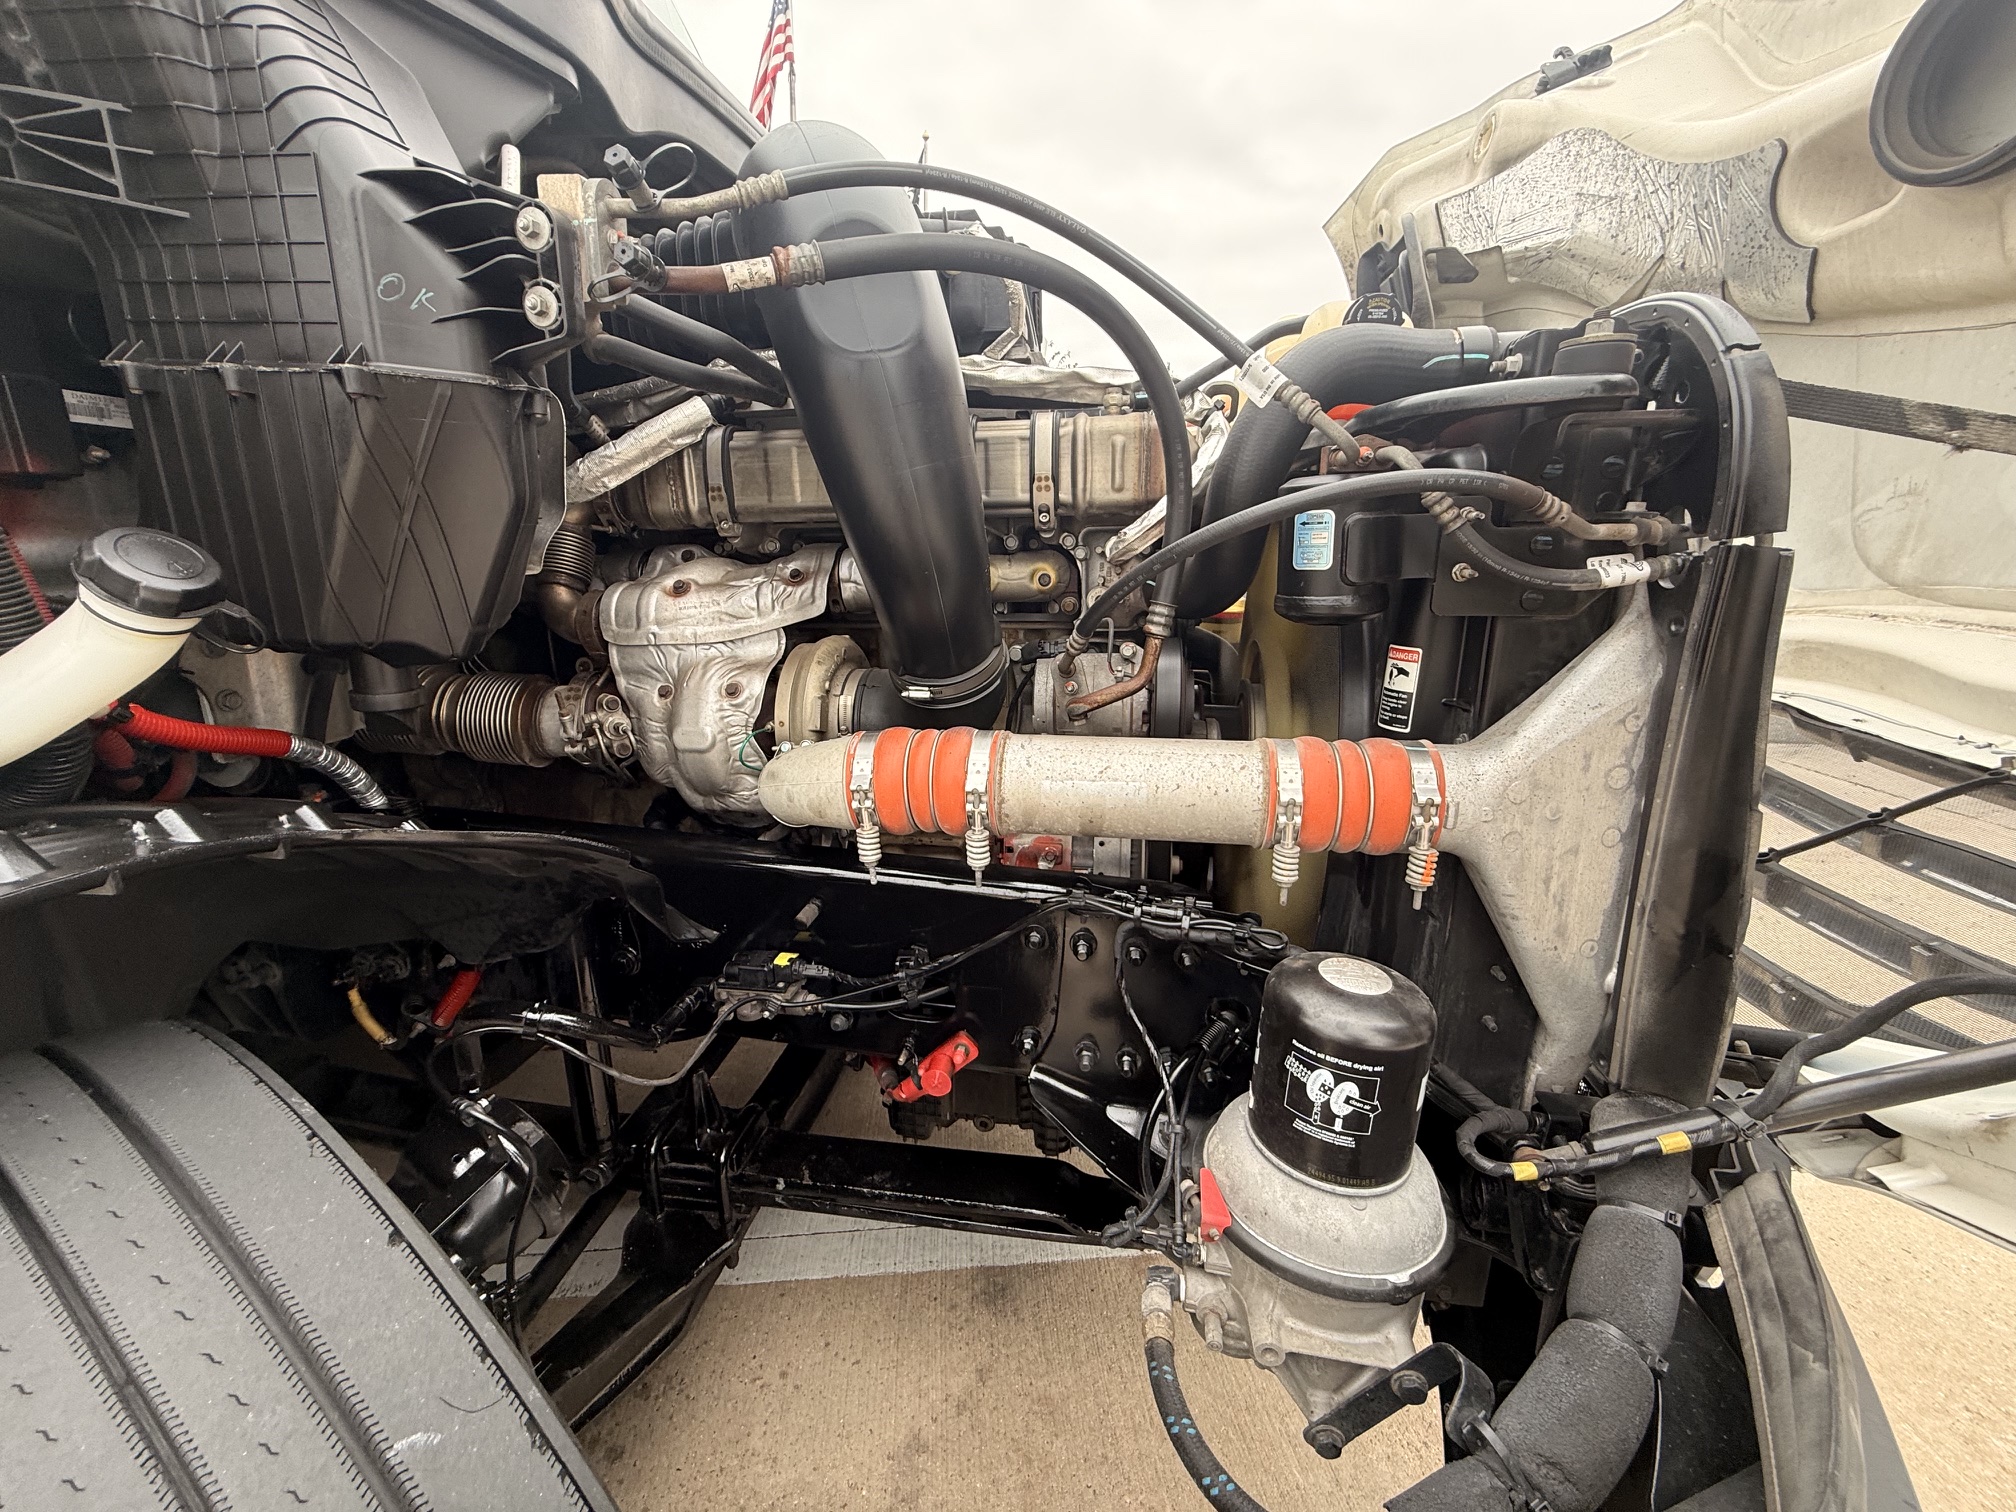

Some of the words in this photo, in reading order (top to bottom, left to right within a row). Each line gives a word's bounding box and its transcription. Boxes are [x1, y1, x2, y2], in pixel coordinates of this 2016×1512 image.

[1008, 191, 1023, 201] HOSE
[1057, 214, 1087, 234] GALAXY
[376, 272, 437, 312] OK
[1482, 556, 1501, 571] (10mm)
[1501, 568, 1521, 579] R-134a
[1393, 651, 1418, 661] DANGER
[1292, 1039, 1316, 1056] Removes
[1326, 1055, 1352, 1068] BEFORE
[1353, 1063, 1373, 1072] drying
[1349, 1099, 1363, 1109] clean
